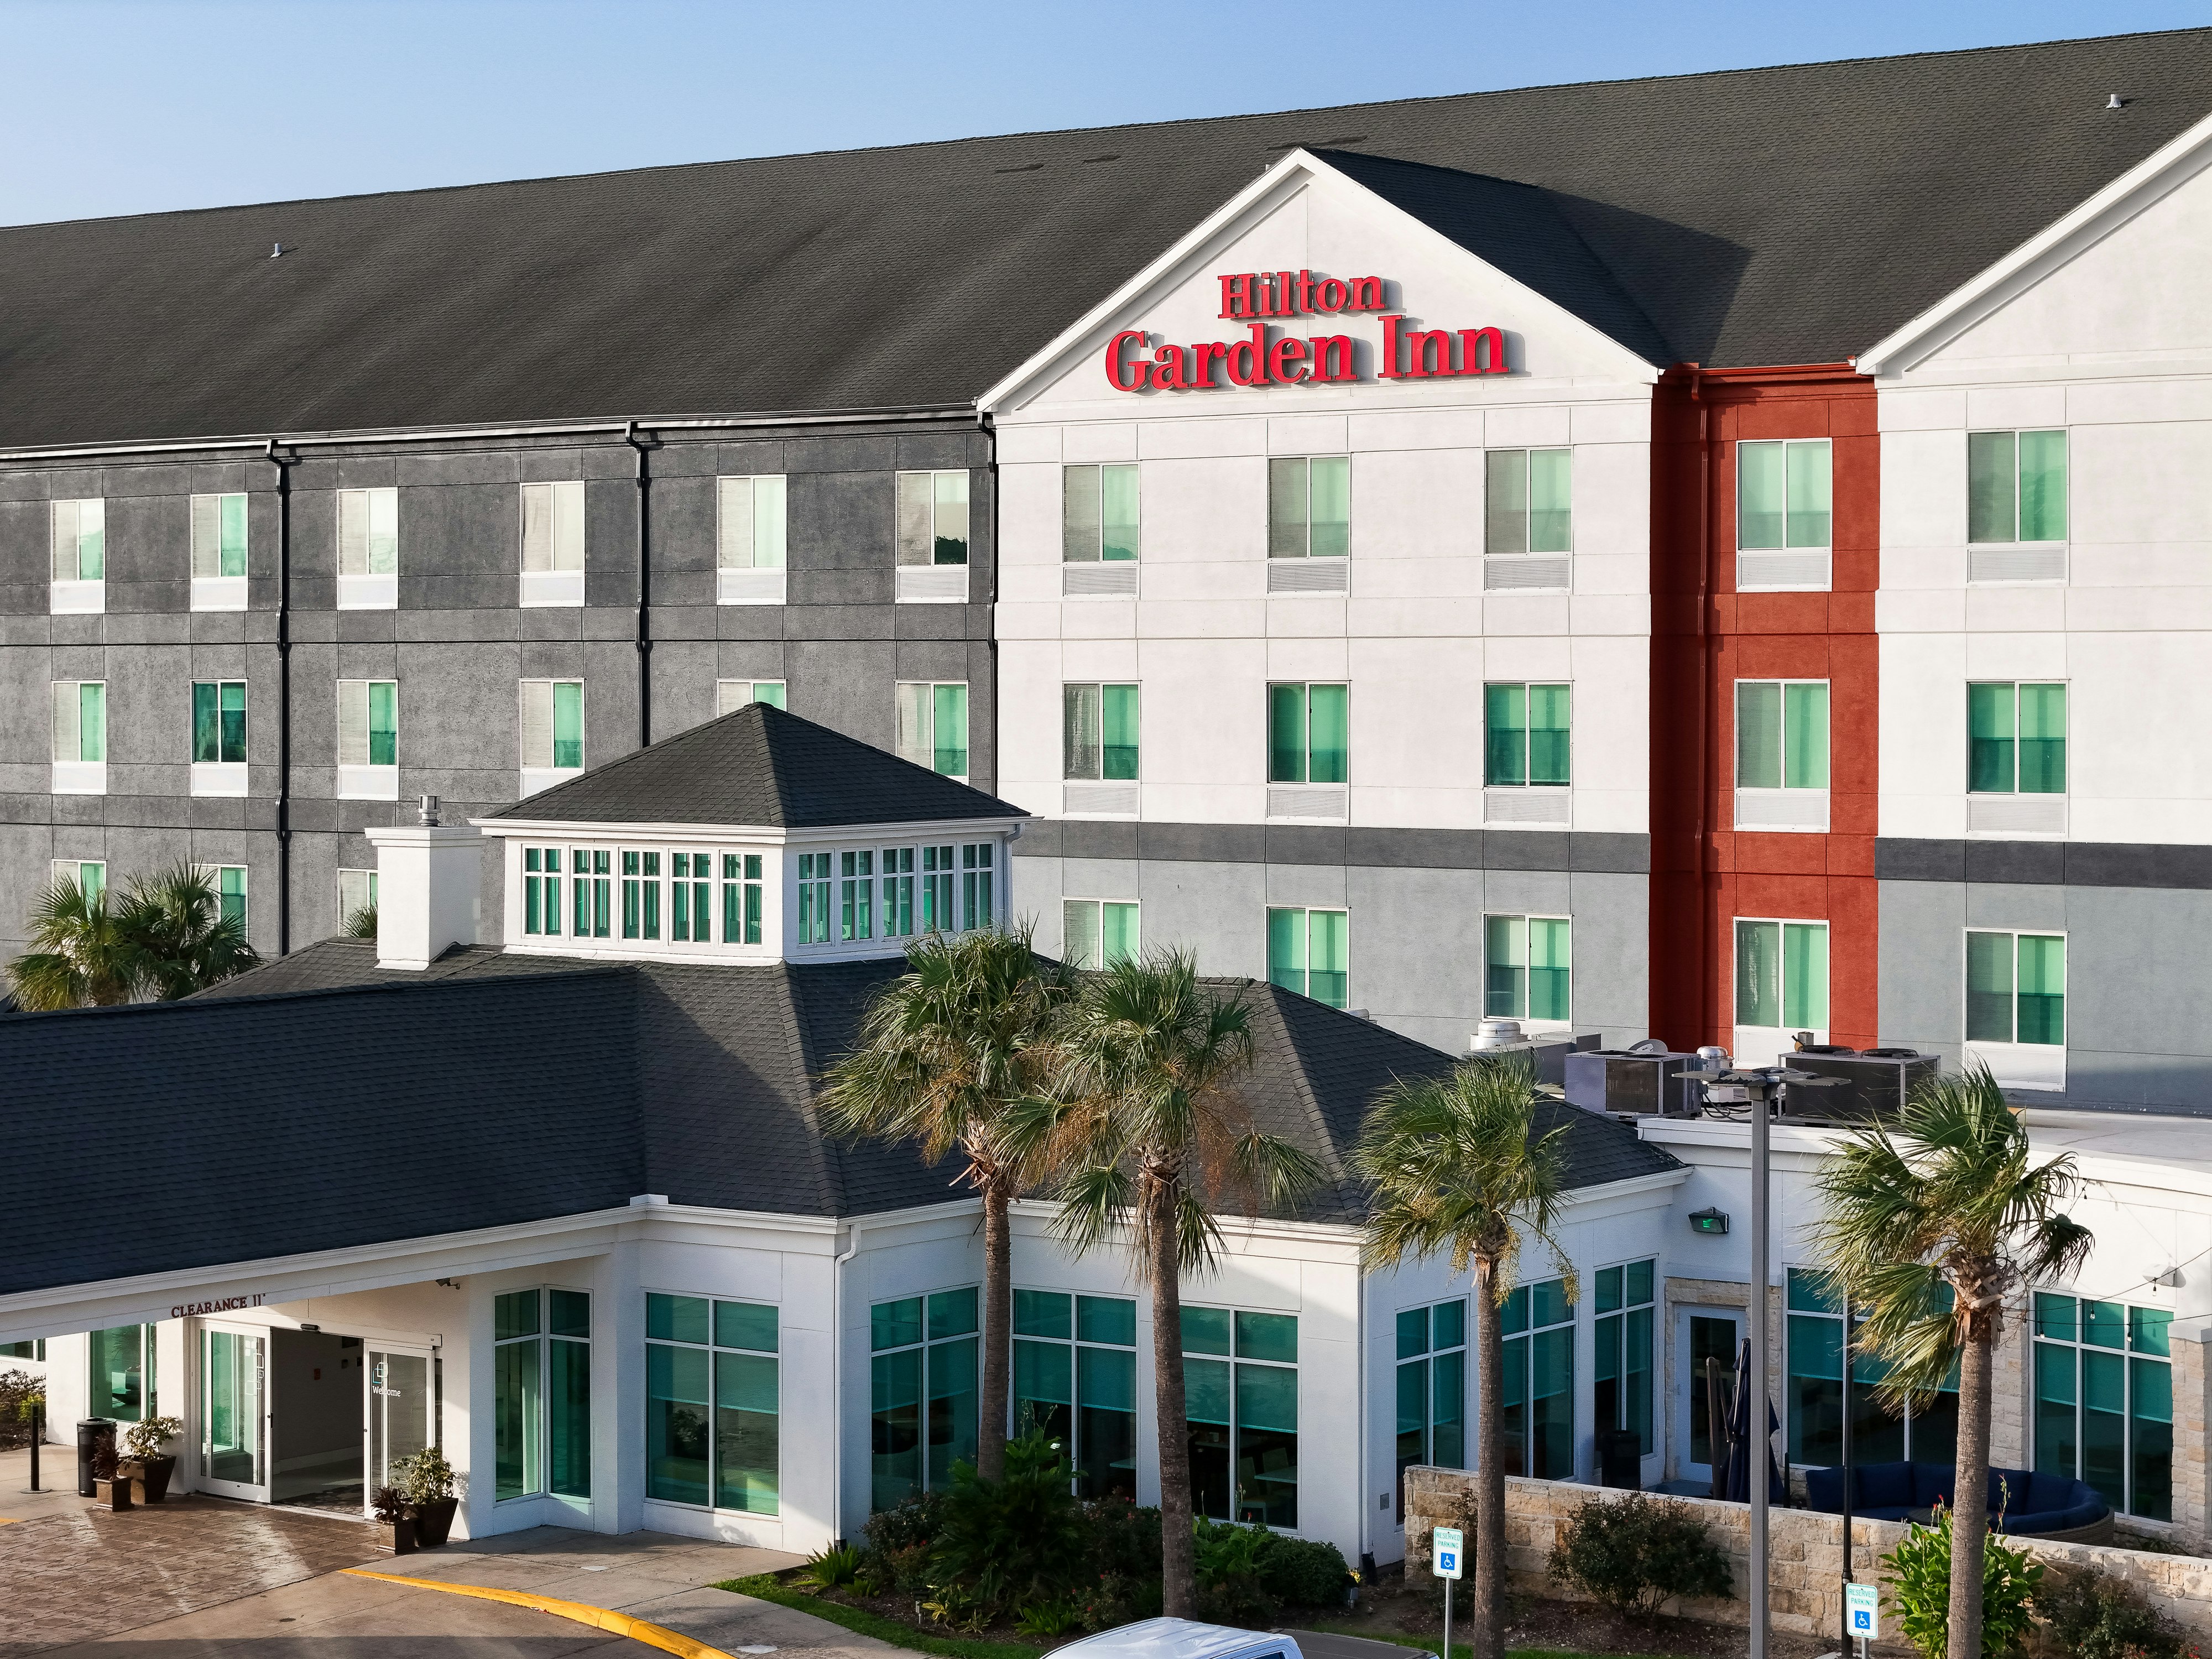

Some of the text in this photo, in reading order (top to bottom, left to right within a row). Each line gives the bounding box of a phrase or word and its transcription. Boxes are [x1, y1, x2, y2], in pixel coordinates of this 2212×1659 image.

[1217, 269, 1386, 319] Hilton
[1105, 315, 1510, 392] Garden Inn
[171, 1296, 248, 1318] CLEARANCE
[372, 1385, 401, 1397] Welcome
[1436, 1532, 1460, 1541] RESERVED
[1438, 1541, 1458, 1549] PARKING
[1849, 1589, 1875, 1598] RESERVED
[1851, 1598, 1873, 1606] PARKING
